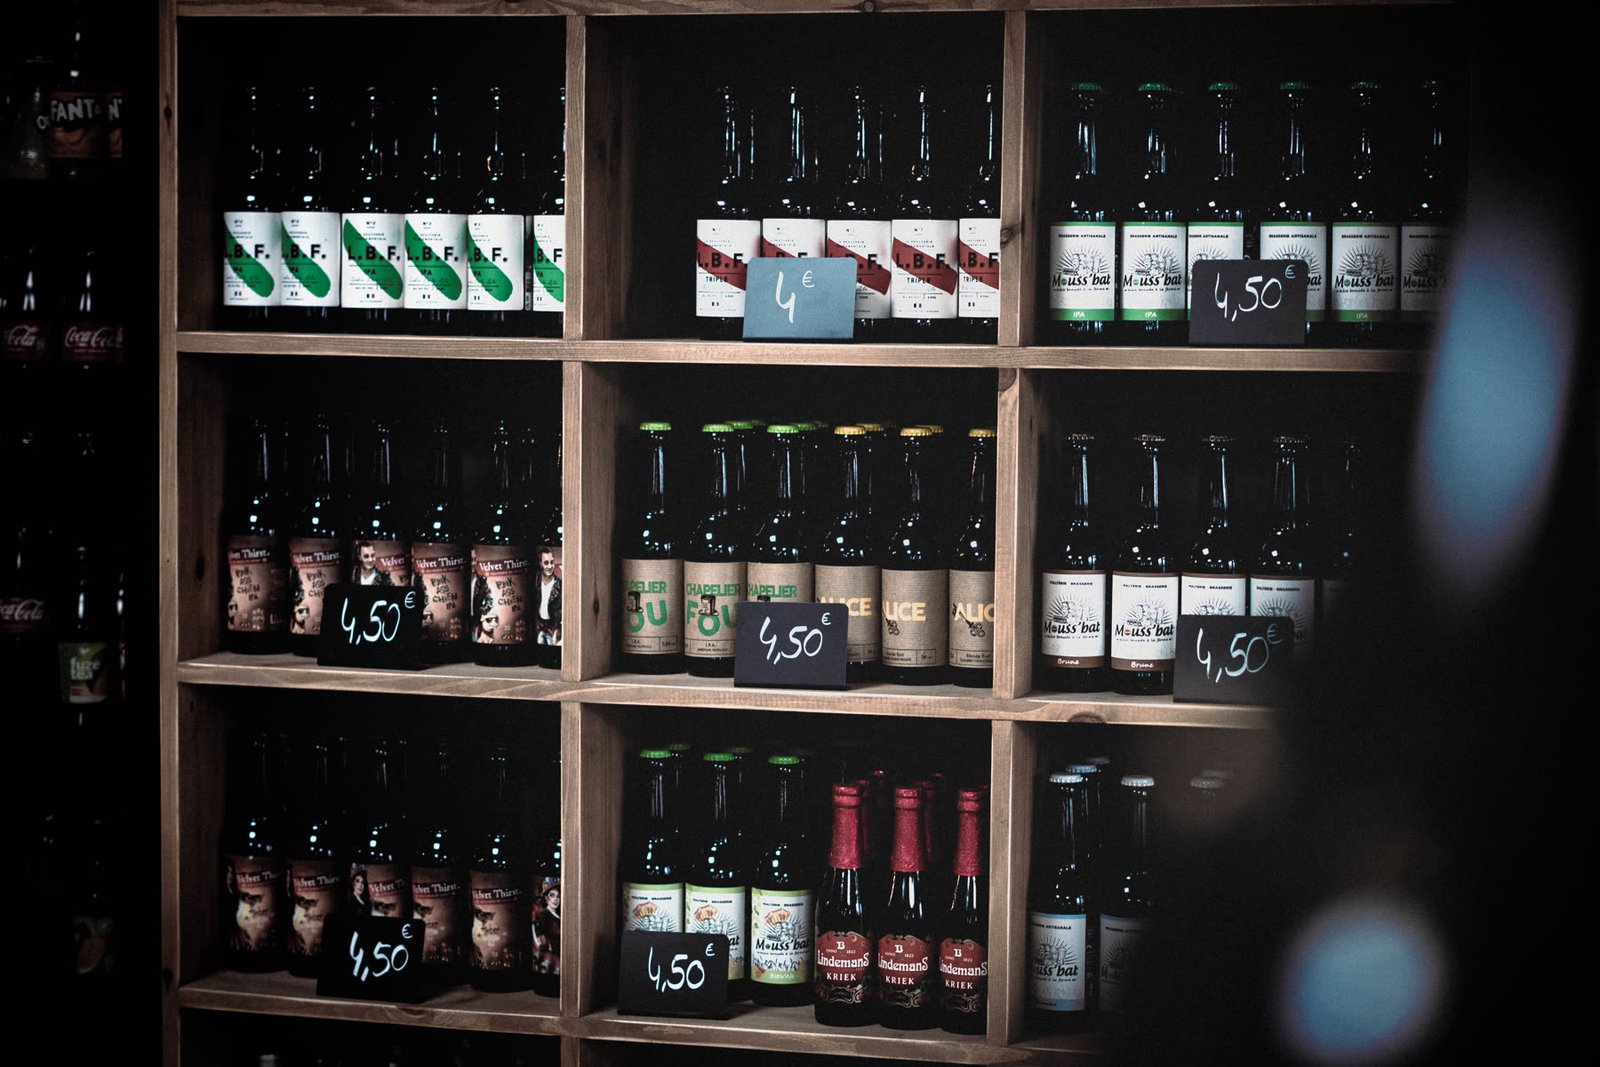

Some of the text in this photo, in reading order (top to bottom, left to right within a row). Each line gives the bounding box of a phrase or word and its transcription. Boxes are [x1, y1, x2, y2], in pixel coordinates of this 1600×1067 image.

[1131, 661, 1154, 669] Brune
[826, 972, 857, 981] KRIEK
[885, 975, 915, 985] KRIEK
[945, 979, 973, 989] KRIEK
